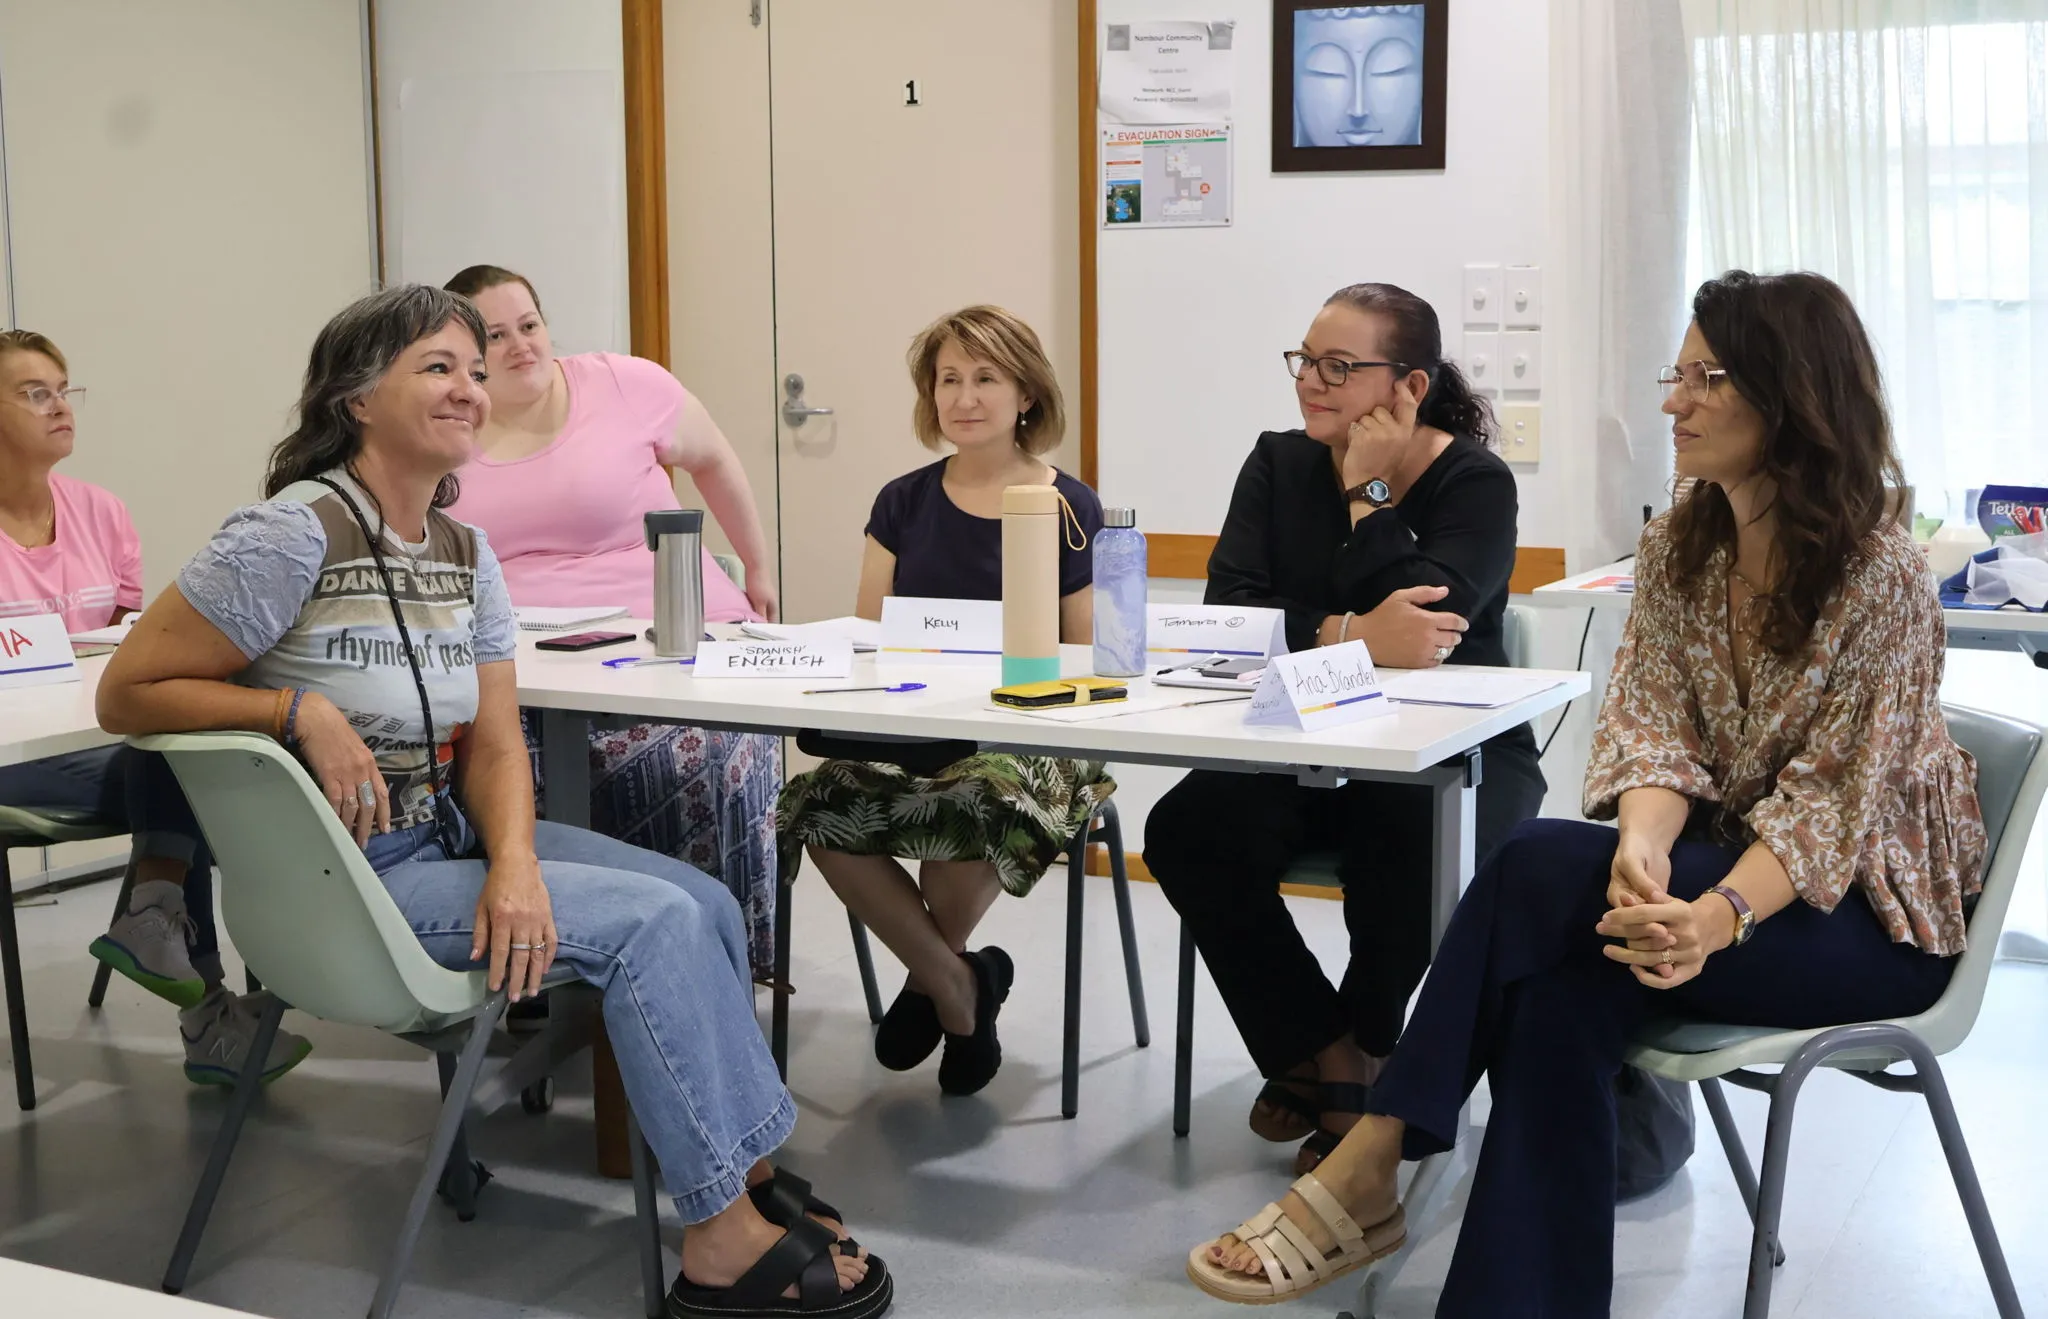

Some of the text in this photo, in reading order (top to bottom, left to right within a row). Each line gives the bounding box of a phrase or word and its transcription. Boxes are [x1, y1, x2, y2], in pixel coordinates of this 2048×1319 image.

[1165, 34, 1203, 42] Community
[1158, 47, 1179, 55] Centre
[906, 80, 918, 104] 1
[1118, 130, 1181, 141] EVACUATION
[1184, 129, 1209, 139] SIGN
[320, 570, 406, 593] DANCE
[326, 628, 408, 670] rhyme
[414, 634, 434, 668] of
[728, 654, 824, 667] ENGLISH
[1294, 665, 1327, 695] Ana
